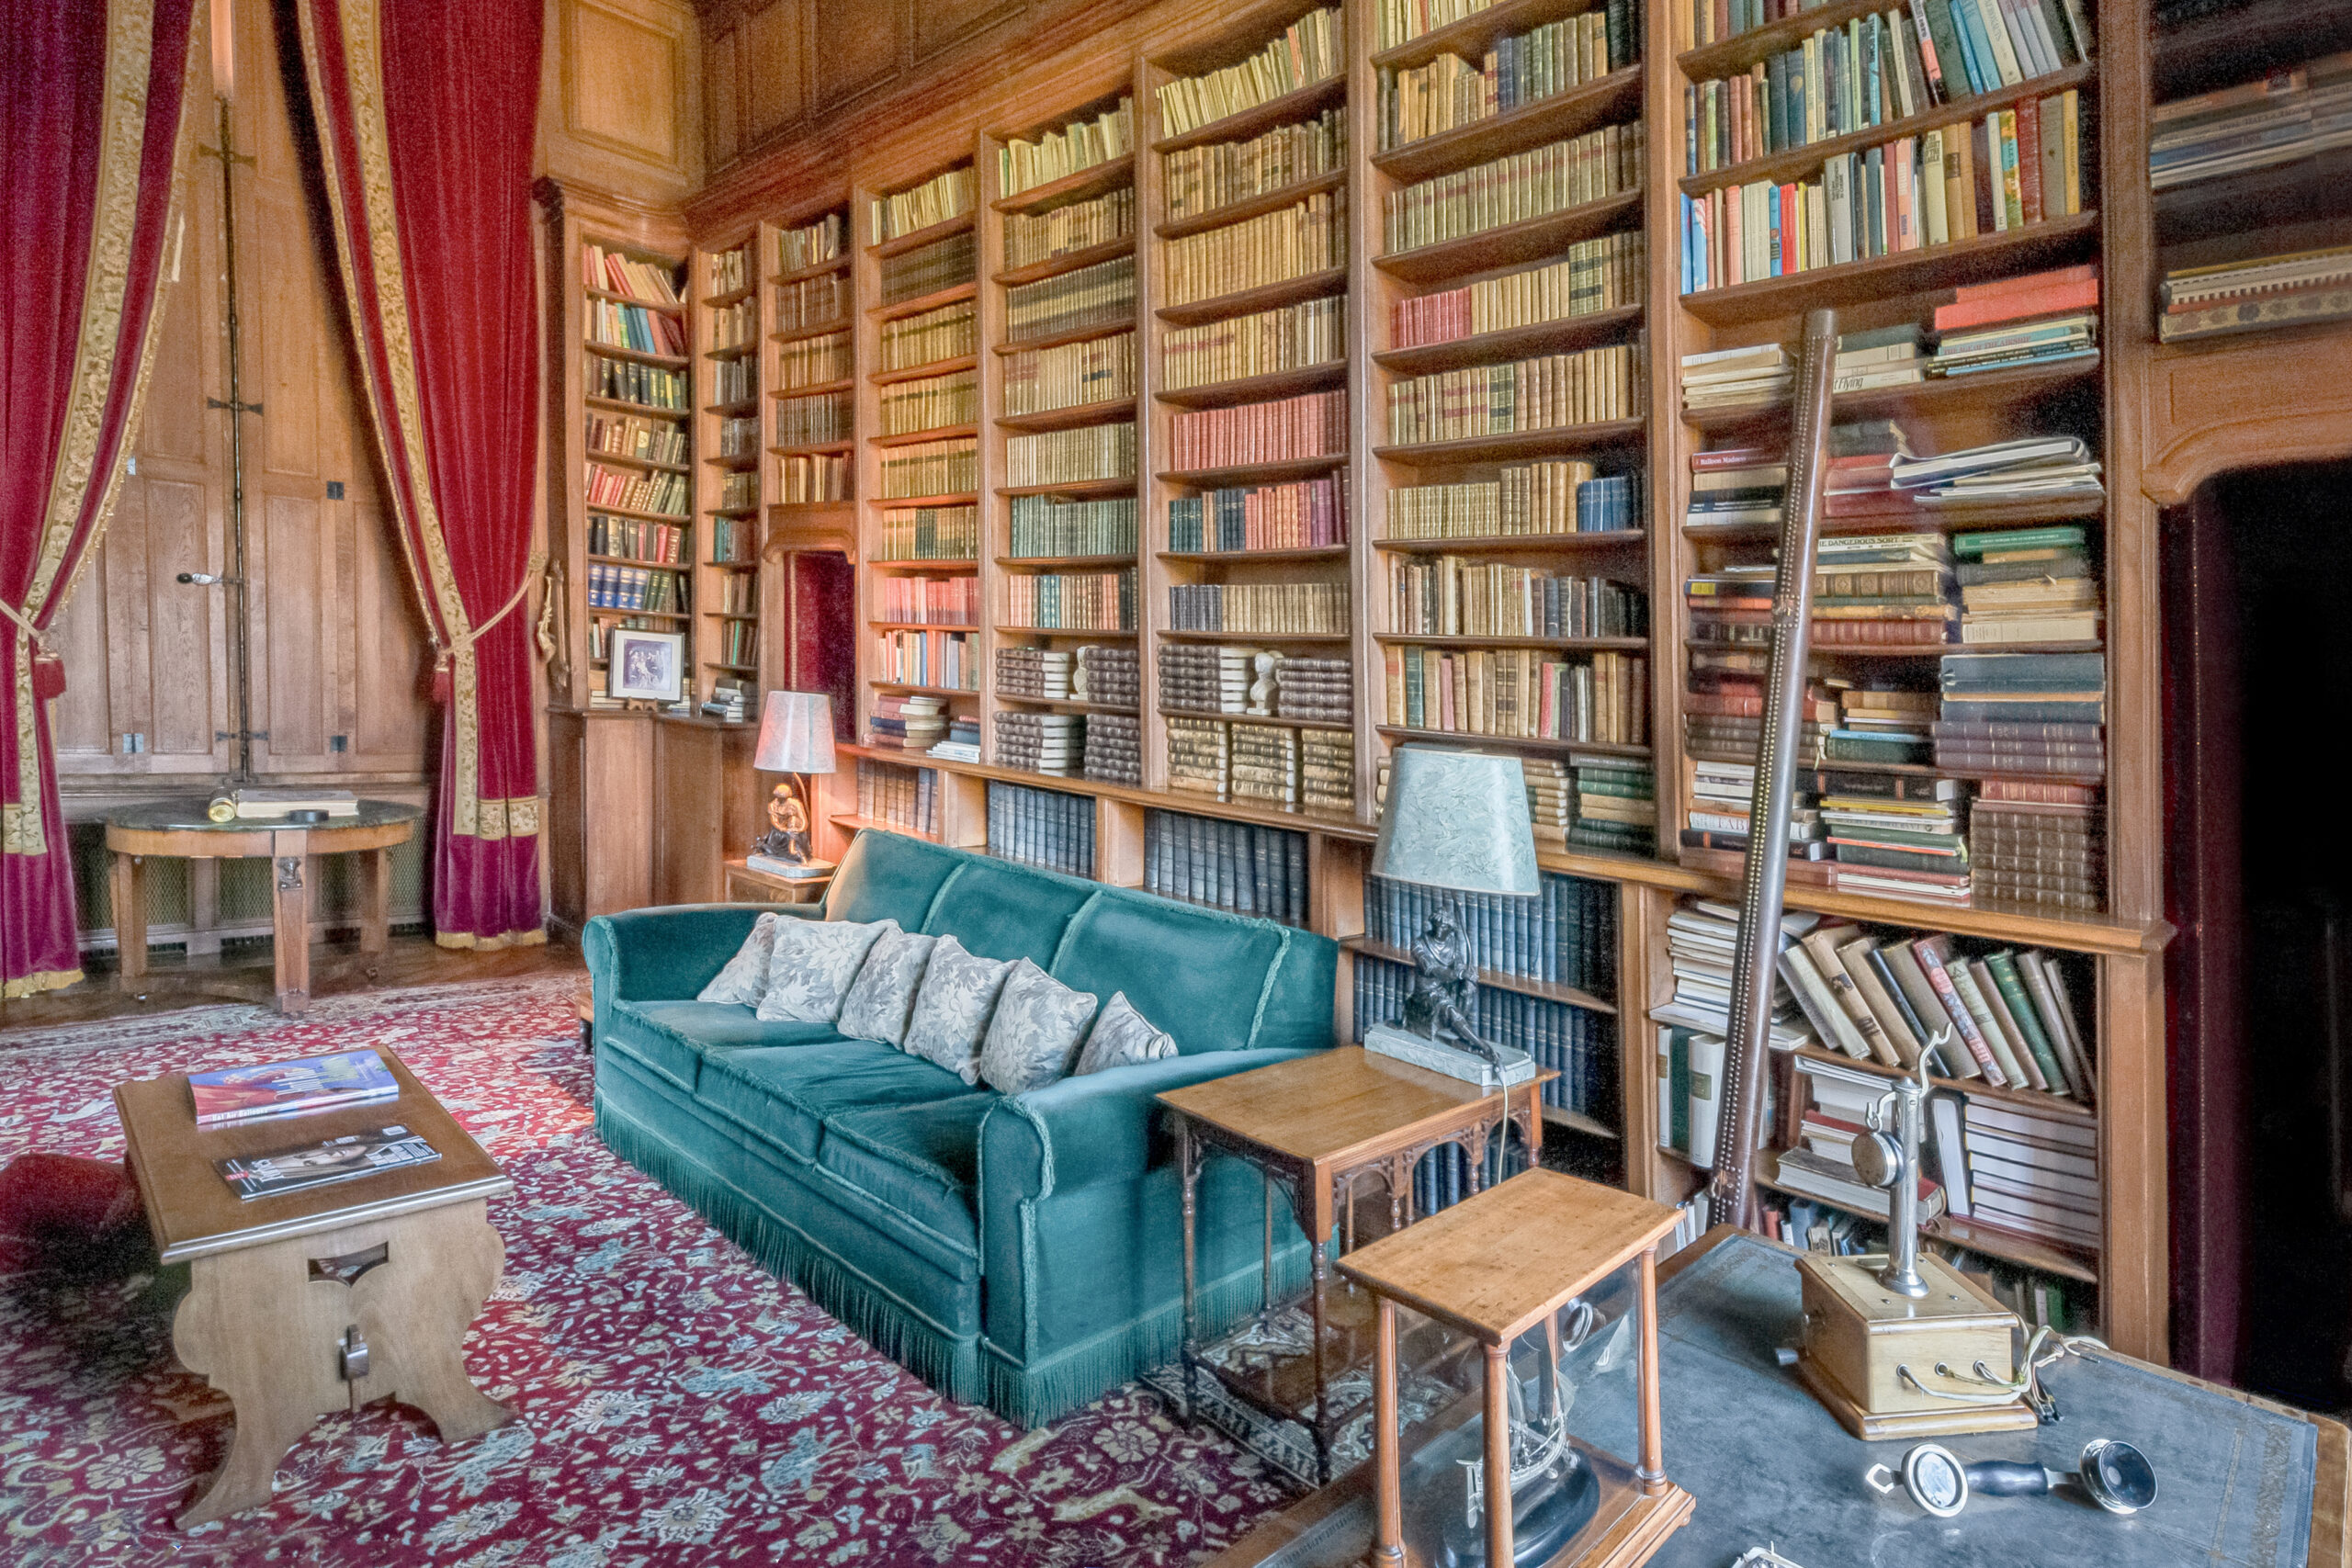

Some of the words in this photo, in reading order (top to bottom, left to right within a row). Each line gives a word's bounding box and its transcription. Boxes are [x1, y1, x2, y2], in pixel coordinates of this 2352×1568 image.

[1838, 377, 1863, 390] Flying
[1828, 537, 1875, 547] DANGEROUS
[1876, 536, 1898, 544] SORT
